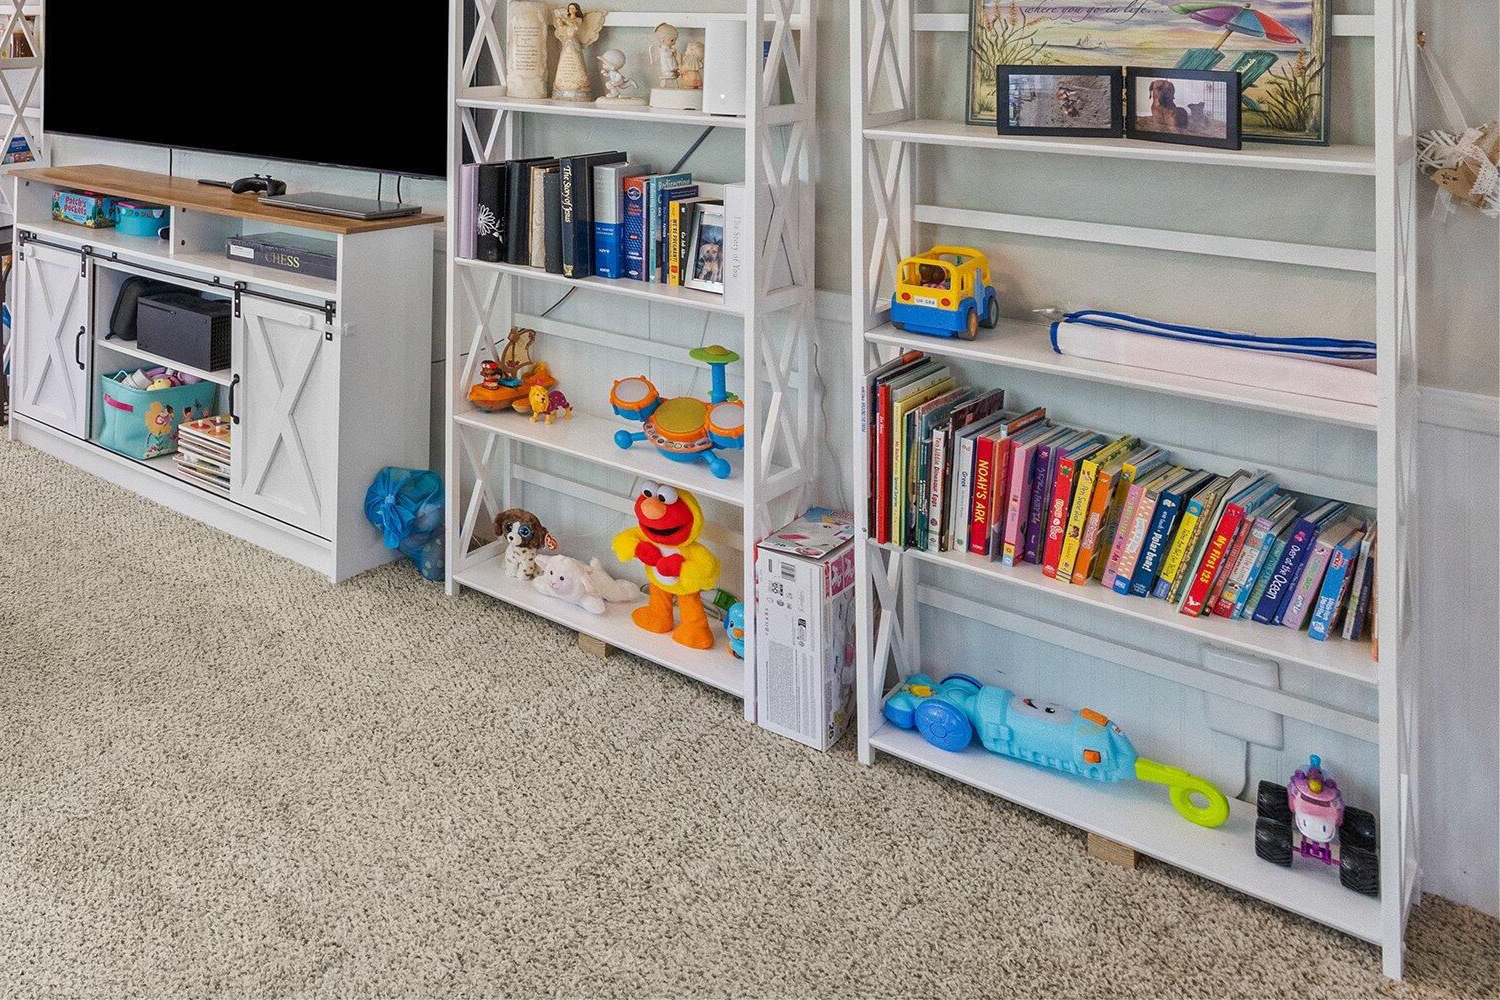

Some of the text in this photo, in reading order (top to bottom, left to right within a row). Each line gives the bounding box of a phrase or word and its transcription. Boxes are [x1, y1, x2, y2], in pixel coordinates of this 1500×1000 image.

[1024, 0, 1057, 13] where
[1050, 6, 1083, 21] you
[1105, 4, 1119, 14] in
[563, 165, 573, 181] The
[562, 181, 572, 197] Story
[562, 204, 573, 223] Jesus
[733, 216, 741, 230] The
[732, 231, 740, 252] Story
[264, 251, 300, 268] CHESS
[732, 264, 740, 279] You
[934, 448, 942, 465] Little
[933, 465, 941, 493] Dinosaur
[974, 459, 989, 524] NOAH'S ARK
[1148, 532, 1163, 552] polar
[1213, 535, 1227, 549] My
[1141, 550, 1157, 572] bear!
[1206, 549, 1221, 570] First
[1288, 544, 1301, 560] Over
[1266, 574, 1288, 600] Ocean
